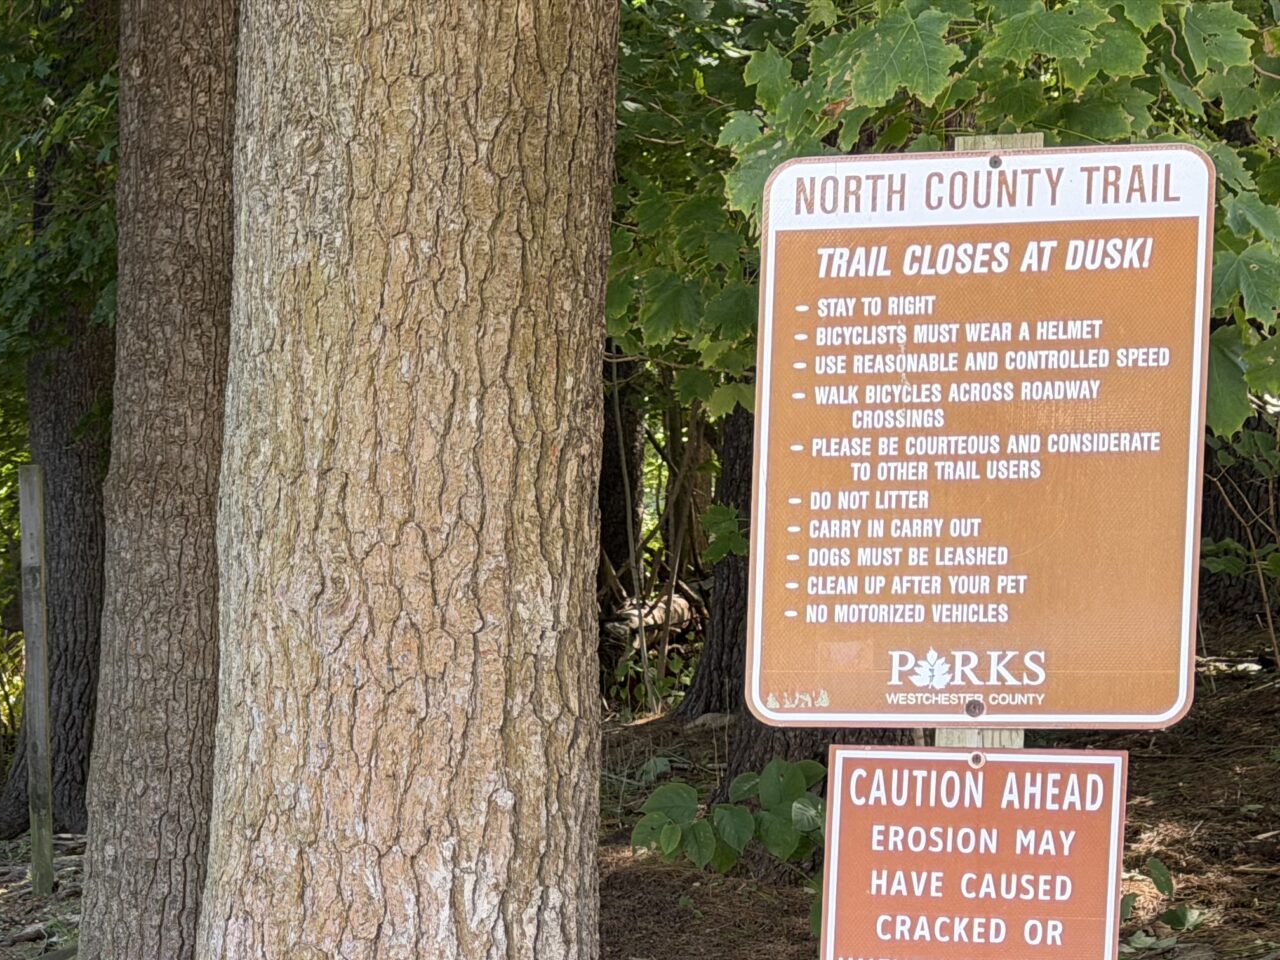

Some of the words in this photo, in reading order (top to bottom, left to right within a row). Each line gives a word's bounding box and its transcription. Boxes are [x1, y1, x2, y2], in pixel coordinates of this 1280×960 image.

[795, 173, 907, 215] NORTH
[925, 168, 1065, 210] COUNTY
[1080, 164, 1180, 204] TRAIL
[817, 247, 891, 278] TRAIL
[903, 242, 1009, 275] CLOSES
[1021, 241, 1058, 272] AT
[1065, 238, 1153, 270] DUSK!
[817, 298, 856, 317] STAY
[861, 297, 882, 316] TO
[888, 296, 935, 315] RIGHT
[816, 325, 906, 346] BICYCLISTS
[913, 323, 959, 343] MUST
[965, 322, 1012, 342] WEAR
[1019, 322, 1030, 341] A
[1036, 320, 1102, 340] HELMET
[815, 355, 847, 374] USE
[853, 353, 958, 373] REASONABLE
[965, 351, 999, 370] AND
[1005, 348, 1110, 370] CONTROLLED
[1117, 348, 1169, 367] SPEED
[815, 385, 859, 405] WALK
[865, 383, 941, 403] BICYCLES
[948, 382, 1014, 402] ACROSS
[1021, 380, 1100, 400] ROADWAY
[852, 409, 944, 429] CROSSINGS
[812, 437, 872, 457] PLEASE
[878, 436, 899, 456] BE
[905, 434, 1001, 455] COURTEOUS
[1006, 434, 1041, 453] AND
[1047, 432, 1160, 453] CONSIDERATE
[851, 462, 871, 482] TO
[877, 461, 929, 481] OTHER
[934, 460, 980, 479] TRAIL
[987, 459, 1041, 479] USERS
[810, 491, 831, 510] DO
[837, 491, 870, 510] NOT
[875, 490, 929, 510] LITTER
[809, 519, 861, 539] CARRY
[867, 519, 884, 538] IN
[890, 518, 944, 538] CARRY
[950, 518, 981, 537] OUT
[808, 547, 851, 567] DOGS
[857, 547, 902, 567] MUST
[908, 547, 929, 566] BE
[935, 547, 1008, 566] LEASHED
[807, 576, 858, 595] CLEAN
[864, 575, 886, 595] UP
[891, 575, 942, 594] AFTER
[948, 575, 990, 594] YOUR
[997, 575, 1027, 594] PET
[806, 603, 828, 623] NO
[834, 603, 925, 623] MOTORIZED
[931, 603, 1008, 623] VEHICLES
[886, 693, 984, 705] WESTCHESTER
[989, 693, 1045, 705] COUNTY
[850, 768, 984, 808] CAUTION
[1001, 772, 1104, 811] AHEAD
[872, 825, 998, 854] EROSION
[1016, 829, 1076, 855] MAY
[871, 869, 943, 897] HAVE
[960, 872, 1073, 900] CAUSED
[876, 914, 1006, 943] CRACKED
[1024, 920, 1063, 945] OR
